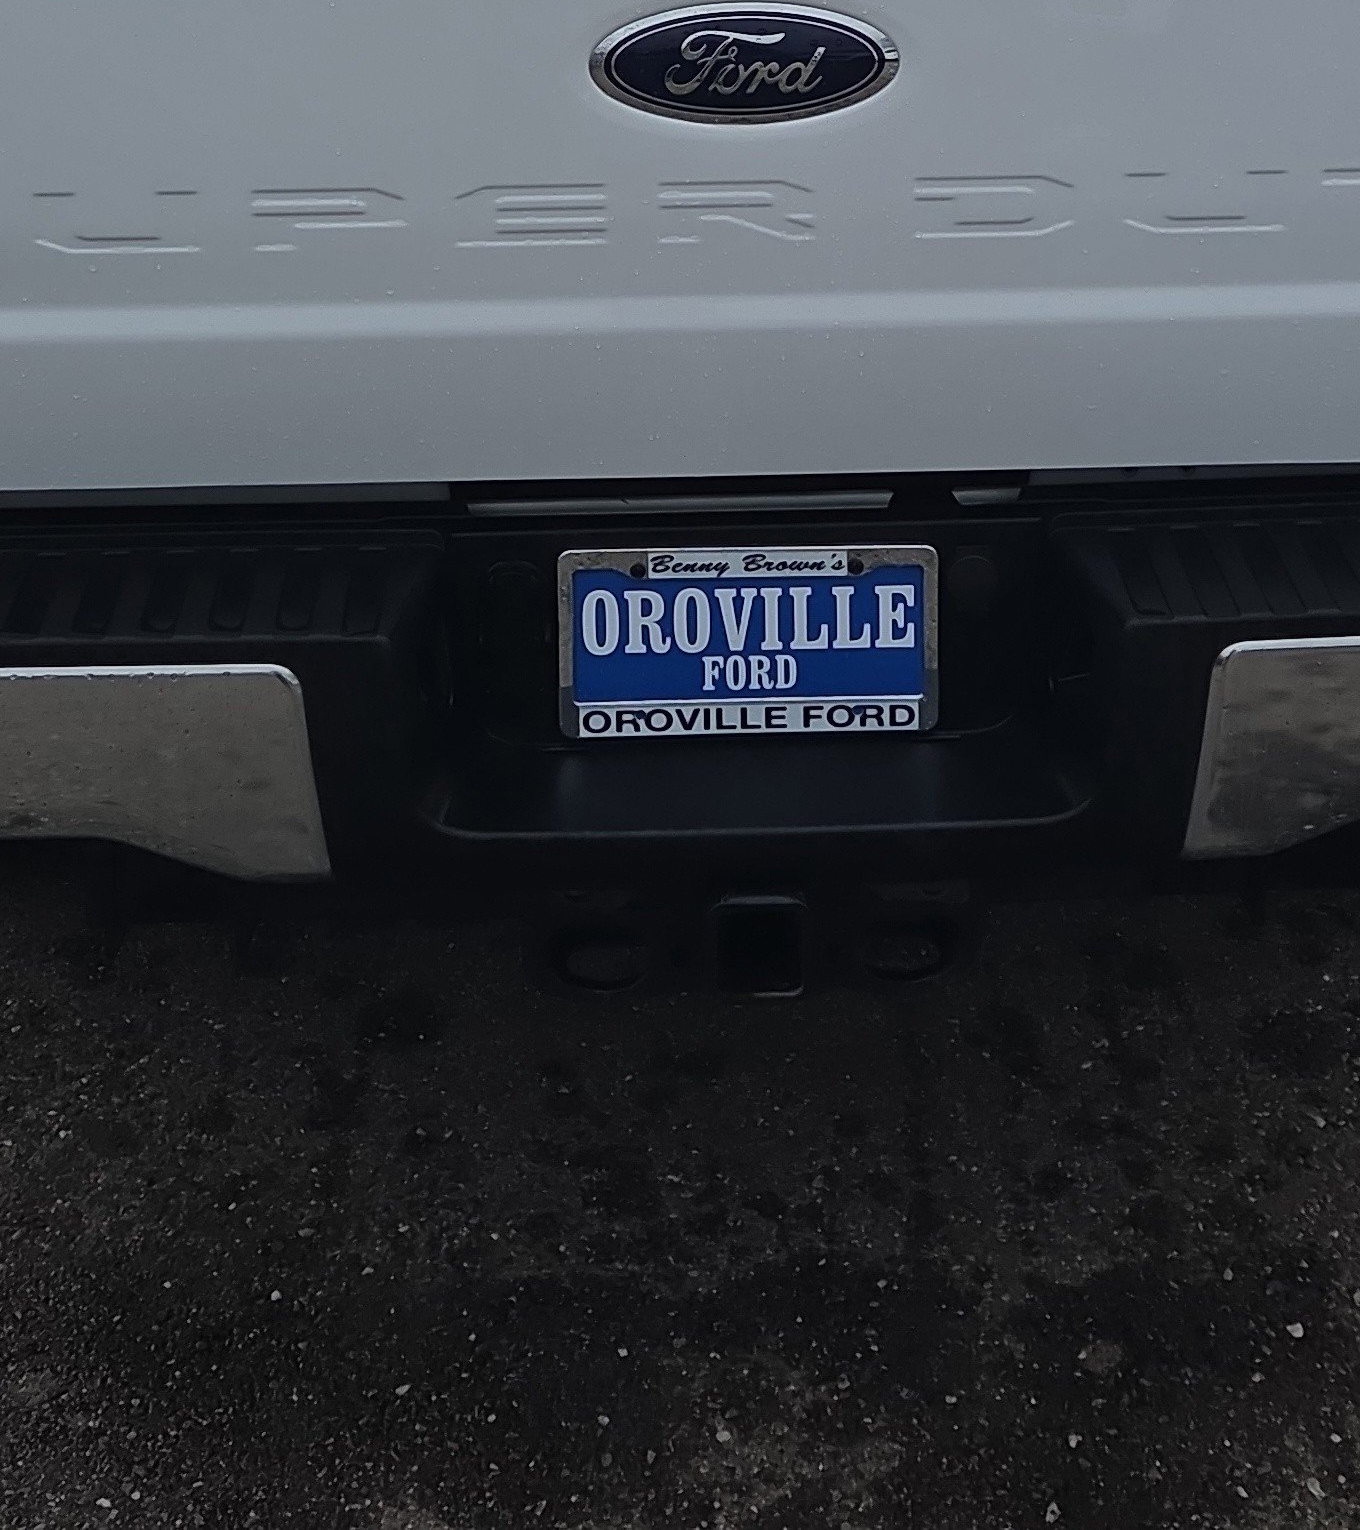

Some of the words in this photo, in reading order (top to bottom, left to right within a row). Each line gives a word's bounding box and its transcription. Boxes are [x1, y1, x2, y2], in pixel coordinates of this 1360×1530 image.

[664, 30, 827, 107] Ford
[650, 554, 731, 577] Benny
[742, 553, 846, 572] Brown's
[582, 584, 915, 656] OROVILLE
[702, 654, 798, 691] FORD
[582, 706, 788, 734] OROVILLE
[802, 704, 917, 728] FORD
